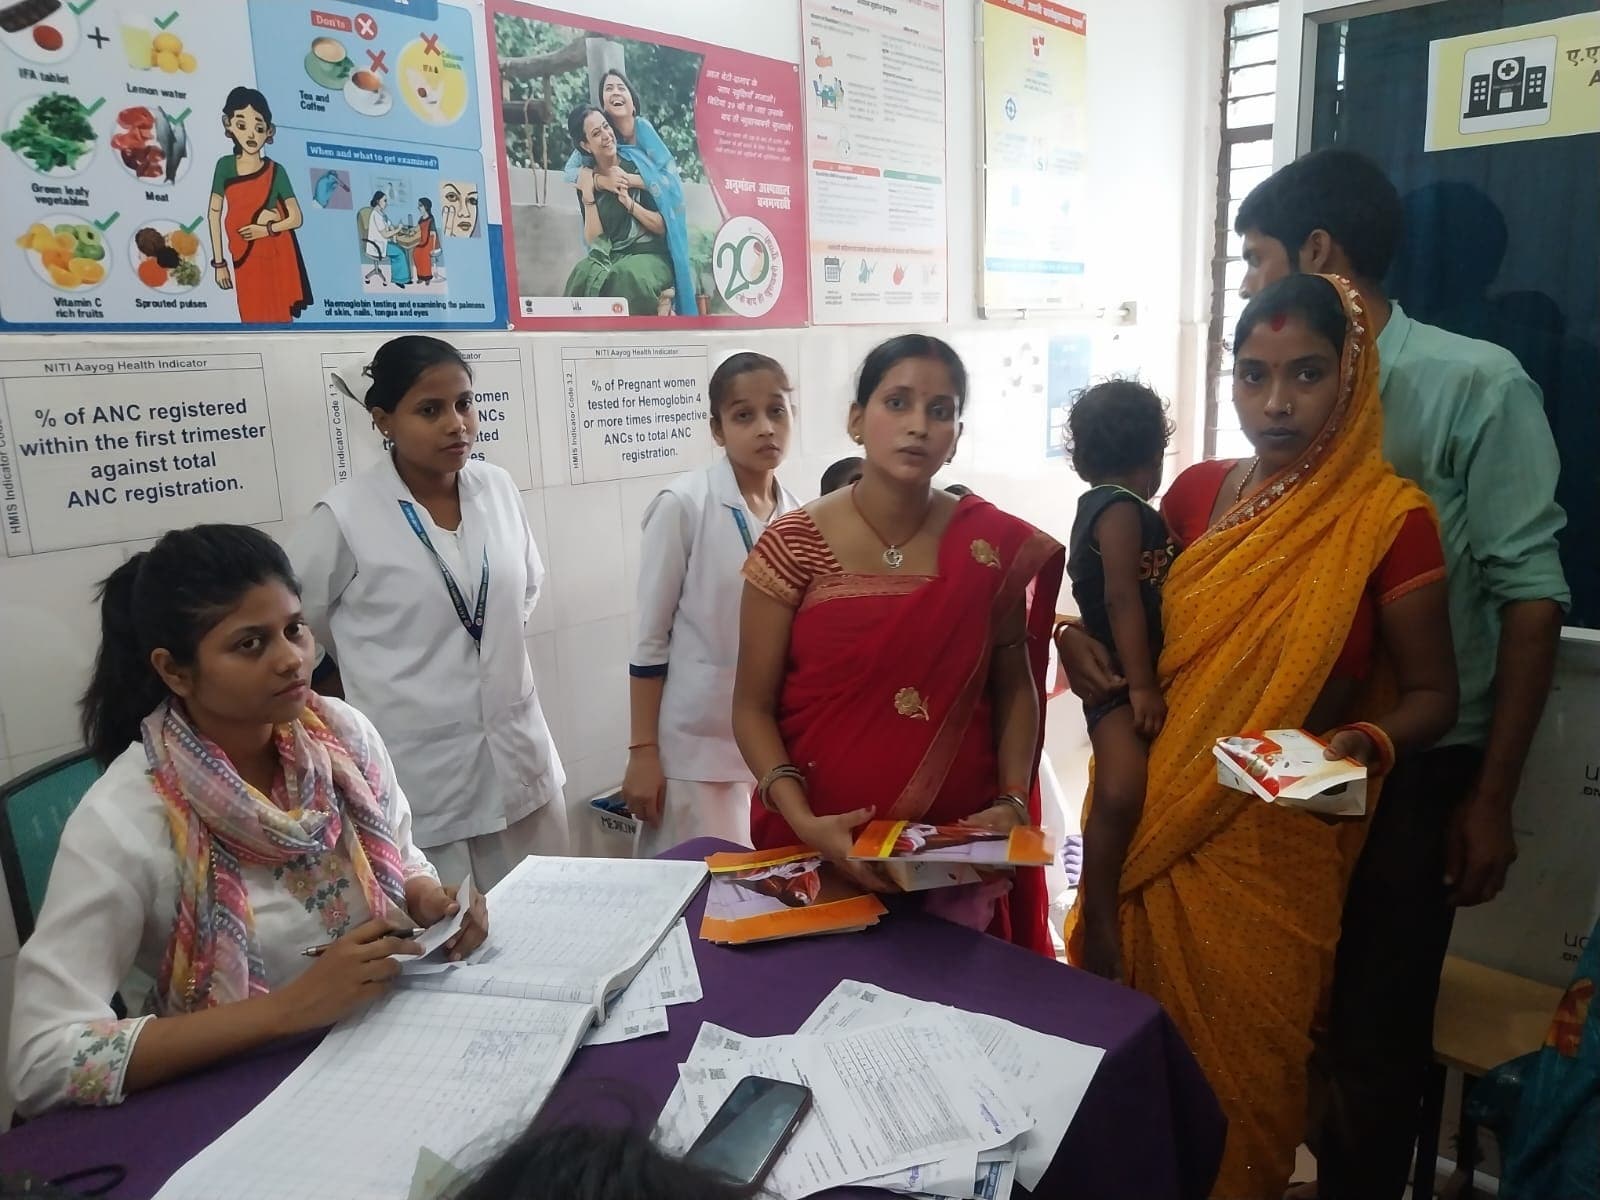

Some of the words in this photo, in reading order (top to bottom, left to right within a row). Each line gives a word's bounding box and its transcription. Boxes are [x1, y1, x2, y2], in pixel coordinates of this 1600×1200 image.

[18, 67, 37, 80] IFA
[40, 71, 70, 84] tablet
[126, 82, 158, 96] Lemon
[161, 86, 187, 99] water
[299, 90, 313, 101] Tea
[315, 92, 330, 103] and
[300, 100, 326, 112] Coffee
[309, 146, 335, 156] When
[336, 149, 352, 158] and
[353, 151, 374, 160] what
[374, 153, 382, 161] to
[384, 156, 396, 164] get
[397, 158, 437, 167] examined?
[31, 182, 62, 195] Green
[65, 185, 90, 198] leafy
[145, 190, 169, 202] Meat
[35, 194, 90, 207] vegetables
[716, 235, 769, 300] 20
[53, 297, 92, 307] Vitamin
[94, 297, 102, 307] C
[135, 298, 177, 309] Sprouted
[179, 299, 208, 309] pulses
[323, 299, 371, 309] Haemoglobin
[373, 300, 397, 309] testing
[399, 300, 411, 308] and
[412, 300, 447, 309] examining
[55, 308, 75, 318] rich
[77, 308, 104, 318] fruits
[325, 308, 333, 316] of
[334, 308, 351, 317] skin,
[354, 308, 373, 317] nails,
[374, 309, 398, 318] tongue
[413, 310, 429, 318] eyes
[595, 349, 610, 357] NITI
[610, 349, 631, 358] Aayog
[632, 348, 651, 356] Health
[44, 362, 71, 373] NITI
[74, 361, 114, 373] Aayog
[117, 361, 155, 370] Health
[158, 359, 208, 369] Indicator
[591, 379, 602, 392] %
[604, 379, 615, 391] of
[617, 378, 661, 392] Pregnant
[663, 378, 696, 388] women
[474, 390, 510, 403] omen
[587, 397, 620, 410] tested
[622, 396, 636, 408] for
[638, 394, 693, 408] Hemoglobin
[695, 393, 702, 402] 4
[35, 408, 56, 427] %
[64, 407, 86, 426] of
[92, 404, 141, 424] ANC
[149, 398, 247, 422] registered
[332, 400, 341, 425] Code
[478, 408, 506, 422] NCs
[583, 419, 595, 429] or
[597, 415, 623, 427] more
[626, 413, 652, 426] times
[654, 410, 708, 425] irrespective
[20, 435, 88, 456] within
[95, 433, 129, 451] the
[135, 429, 176, 447] first
[181, 424, 266, 443] trimester
[604, 432, 633, 445] ANCs
[635, 431, 646, 443] to
[648, 429, 669, 441] total
[670, 426, 692, 439] ANC
[335, 427, 346, 469] Indicator
[621, 446, 679, 463] registration.
[91, 457, 168, 481] against
[173, 451, 217, 470] total
[572, 447, 580, 469] HMIS
[67, 487, 117, 508] ANC
[125, 476, 244, 503] registration.
[7, 503, 21, 534] HMIS
